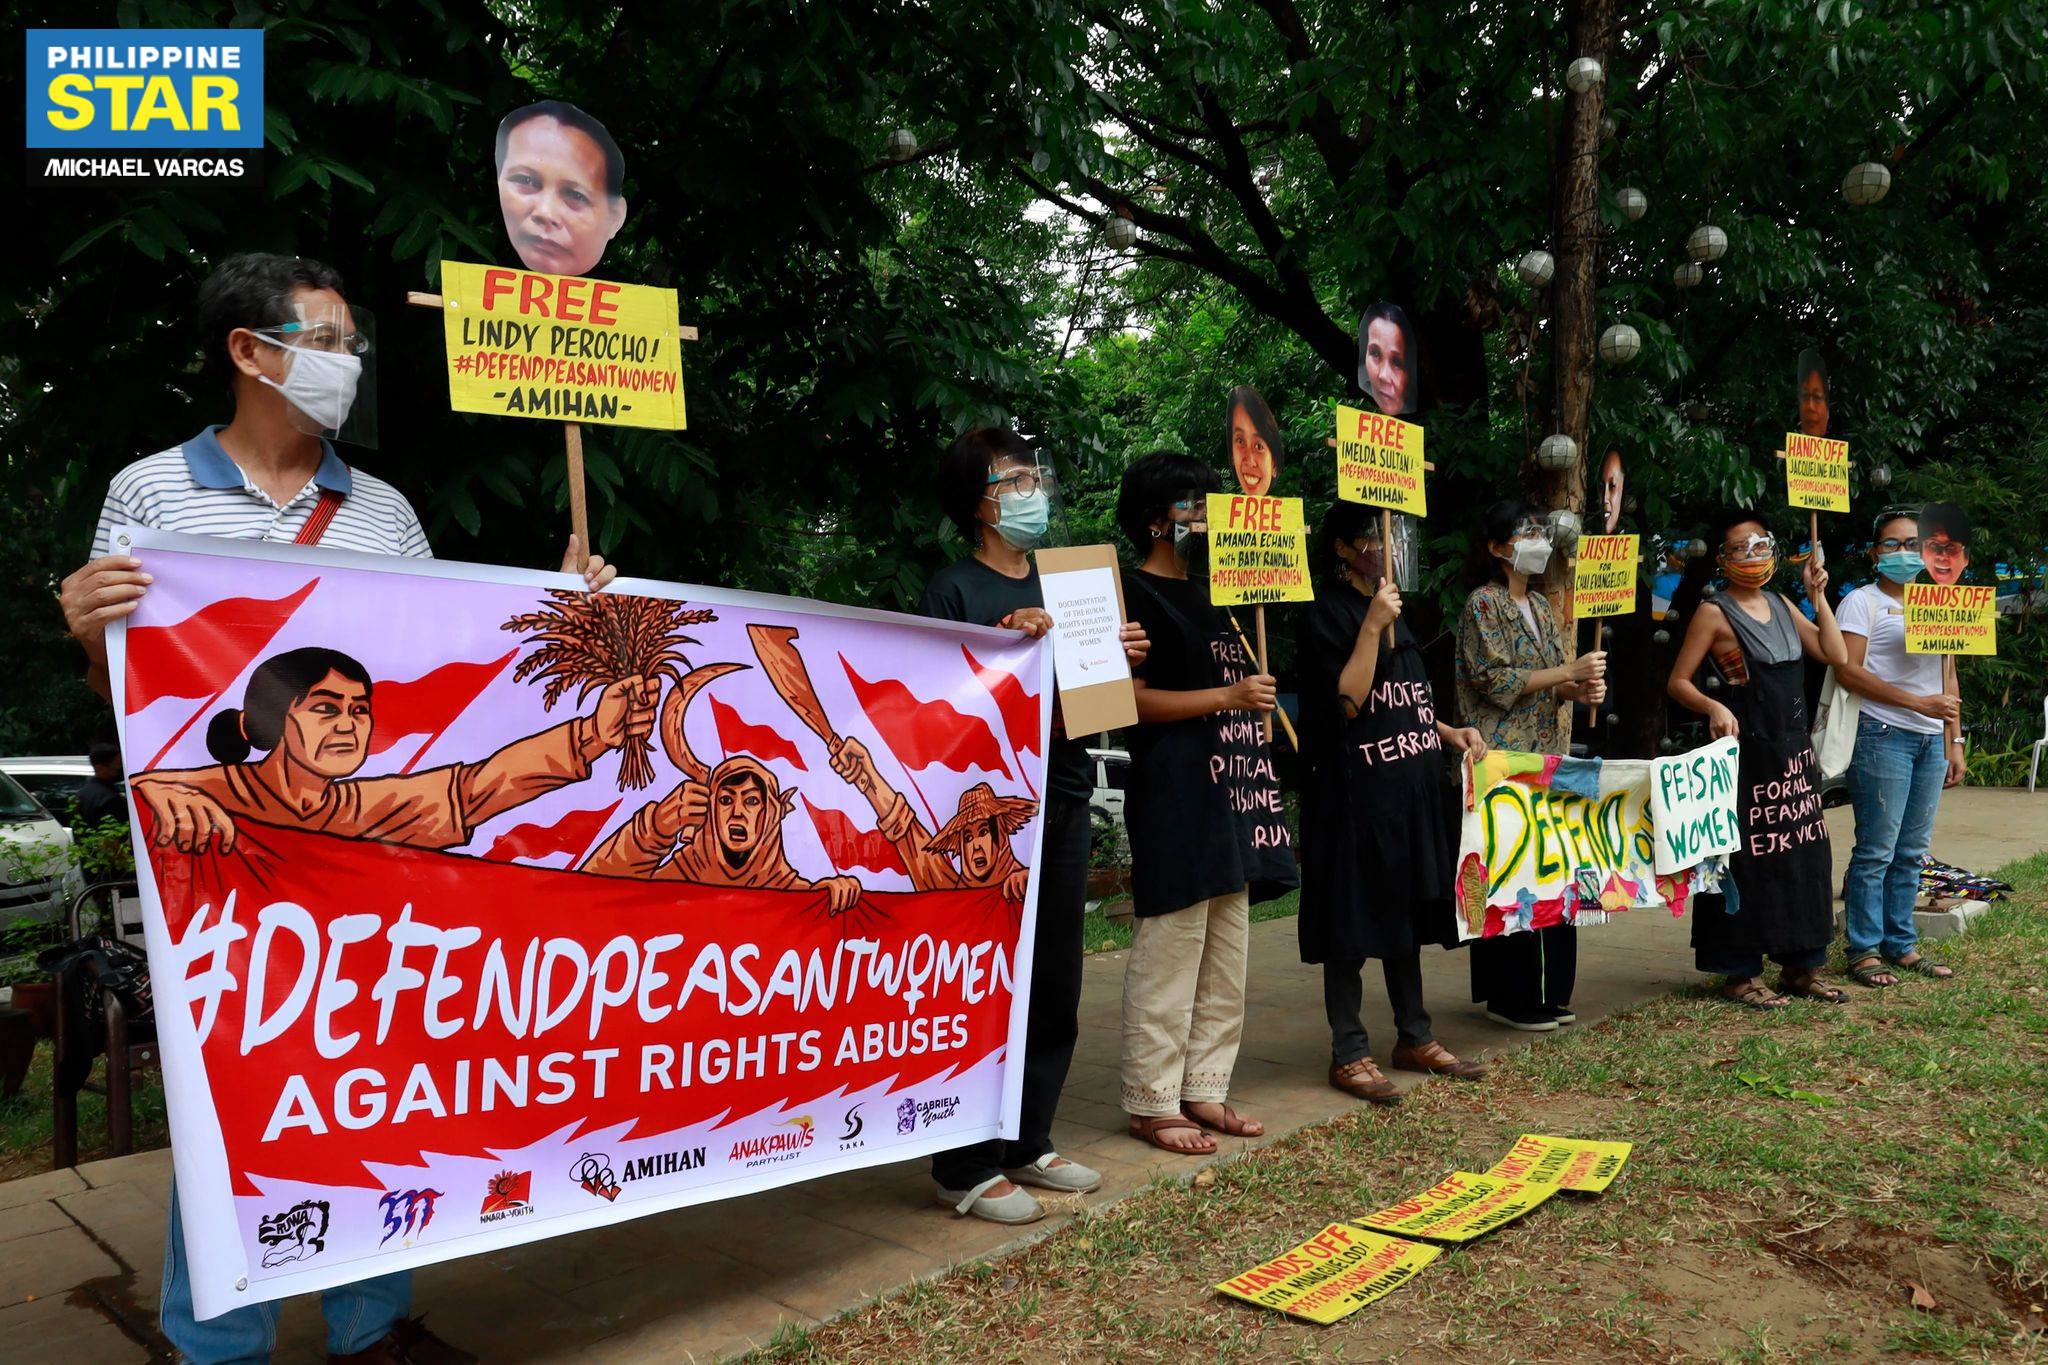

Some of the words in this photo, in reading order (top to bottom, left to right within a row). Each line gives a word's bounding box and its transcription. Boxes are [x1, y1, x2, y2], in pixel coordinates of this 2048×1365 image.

[482, 269, 621, 326] FREE
[463, 318, 541, 353] LINDY
[551, 326, 660, 363] PEROCHO!
[452, 351, 677, 394] #DEFENDPEASANTWOMEN
[493, 386, 632, 419] -AMIHAN-
[1357, 413, 1405, 450] FREE
[1342, 441, 1377, 466] IMELDA
[1380, 448, 1414, 473] SULTAN!
[1788, 434, 1823, 460] HANDS
[1824, 440, 1846, 464] OFF
[1789, 459, 1828, 478] JACQUELINE
[1356, 486, 1408, 504] -AMIHAN-
[1229, 497, 1283, 532] FREE
[1215, 532, 1257, 548] AMANDA
[1260, 532, 1296, 550] ECHANIS
[1580, 537, 1631, 560] JUSTICE
[1218, 552, 1236, 566] with
[1238, 551, 1262, 568] BABY
[1599, 563, 1611, 571] FOR
[1235, 589, 1286, 603] -AMIHAN-
[1907, 586, 1960, 608] HANDS
[1963, 587, 1994, 609] OFF
[1058, 620, 1080, 629] RIGHTS
[1911, 608, 1949, 623] LEONISA
[1063, 629, 1087, 639] AGAINST
[1917, 639, 1970, 651] -AMIHAN-
[1210, 640, 1246, 665] FREE
[1219, 721, 1265, 746] WOME
[1482, 786, 1627, 898] DEFEND
[1666, 807, 1739, 864] WOMEN
[1750, 832, 1792, 856] EJK
[261, 1047, 620, 1143] AGAINST
[640, 1030, 822, 1093] RIGHTS
[833, 1013, 969, 1066] ABUSES
[916, 1096, 960, 1112] GABRIELA
[922, 1104, 955, 1128] Youth
[728, 1124, 815, 1162] ANAKPAWIS
[839, 1140, 865, 1151] SAKA
[1513, 1136, 1548, 1158] OFF
[622, 1146, 707, 1182] AMIHAN
[746, 1151, 801, 1168] PARTY-LIST
[1363, 1198, 1434, 1227] HANDS
[1428, 1176, 1468, 1200] OFF
[276, 1209, 309, 1235] RUWA
[1226, 1253, 1314, 1295] HANDS
[1303, 1225, 1354, 1259] OFF
[1344, 1262, 1414, 1303] -AMIHAN-
[1258, 1286, 1292, 1305] CITA
